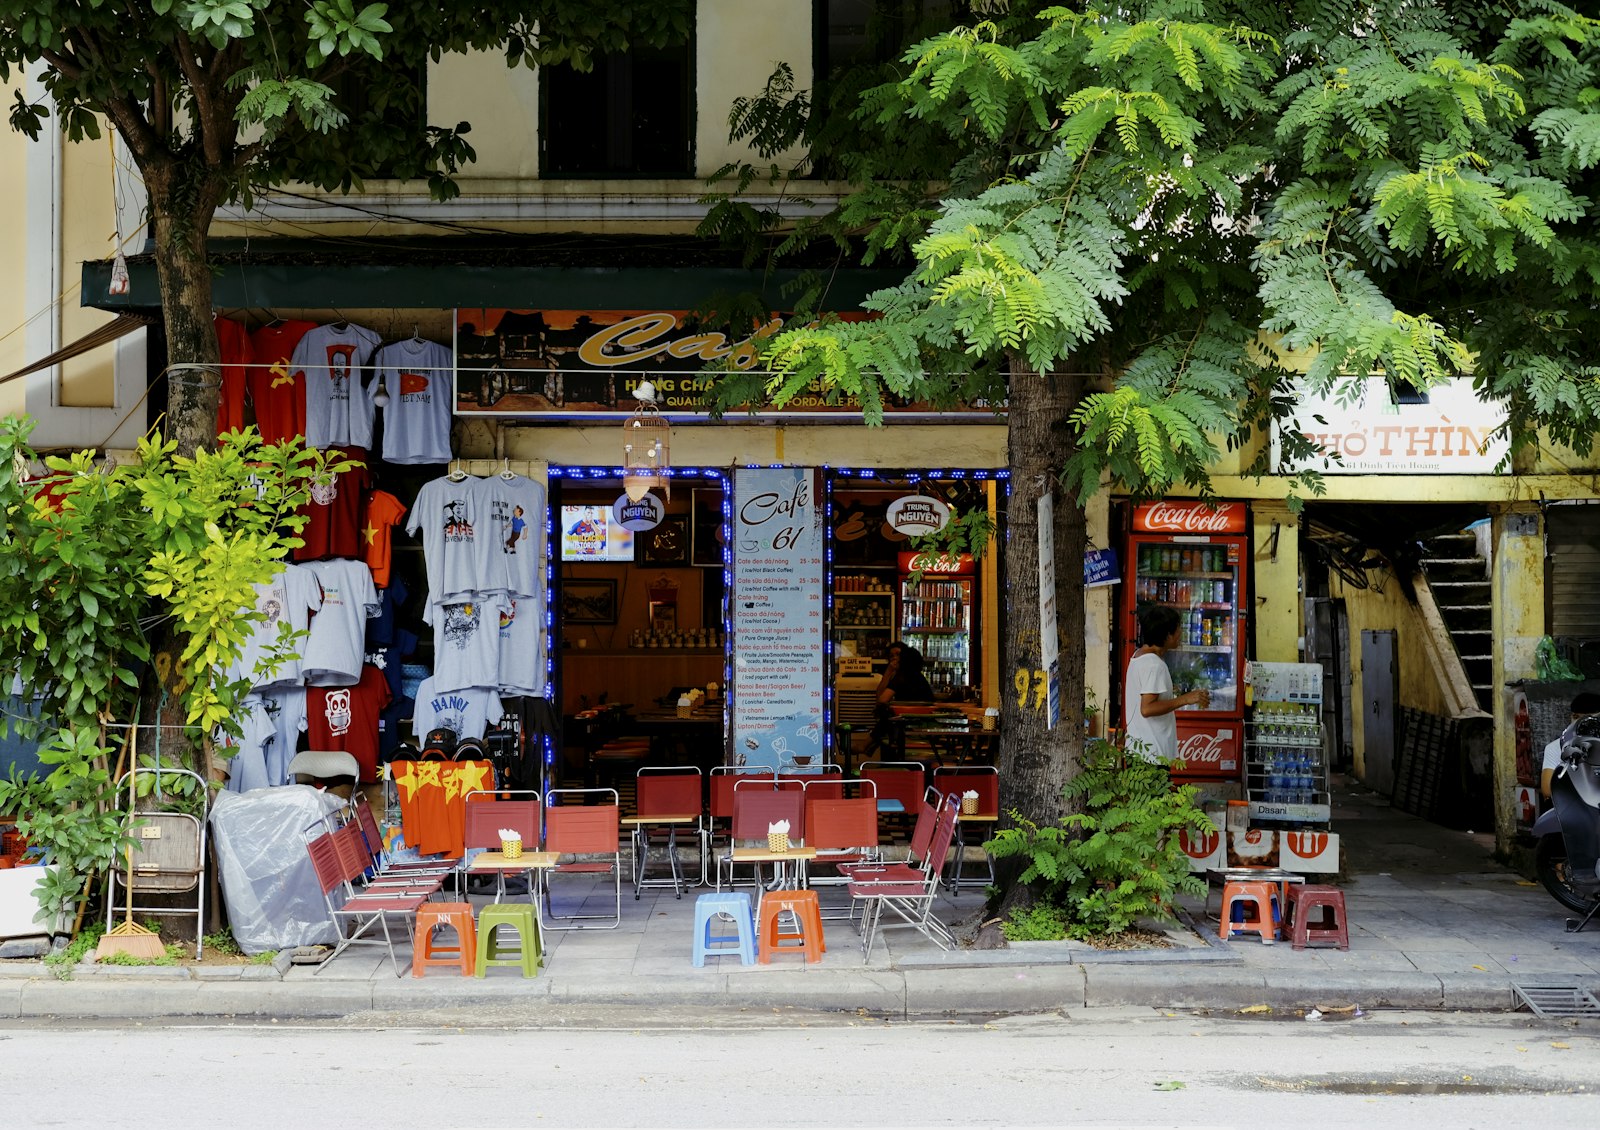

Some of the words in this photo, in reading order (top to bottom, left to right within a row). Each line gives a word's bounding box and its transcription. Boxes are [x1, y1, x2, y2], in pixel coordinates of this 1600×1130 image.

[740, 478, 810, 526] Café
[906, 503, 930, 512] TRUNG
[898, 511, 939, 525] NGUYÊN
[1144, 501, 1234, 531] Coca-Cola
[430, 695, 470, 713] HANOI
[1257, 805, 1287, 815] Dasani
[437, 913, 452, 924] NN
